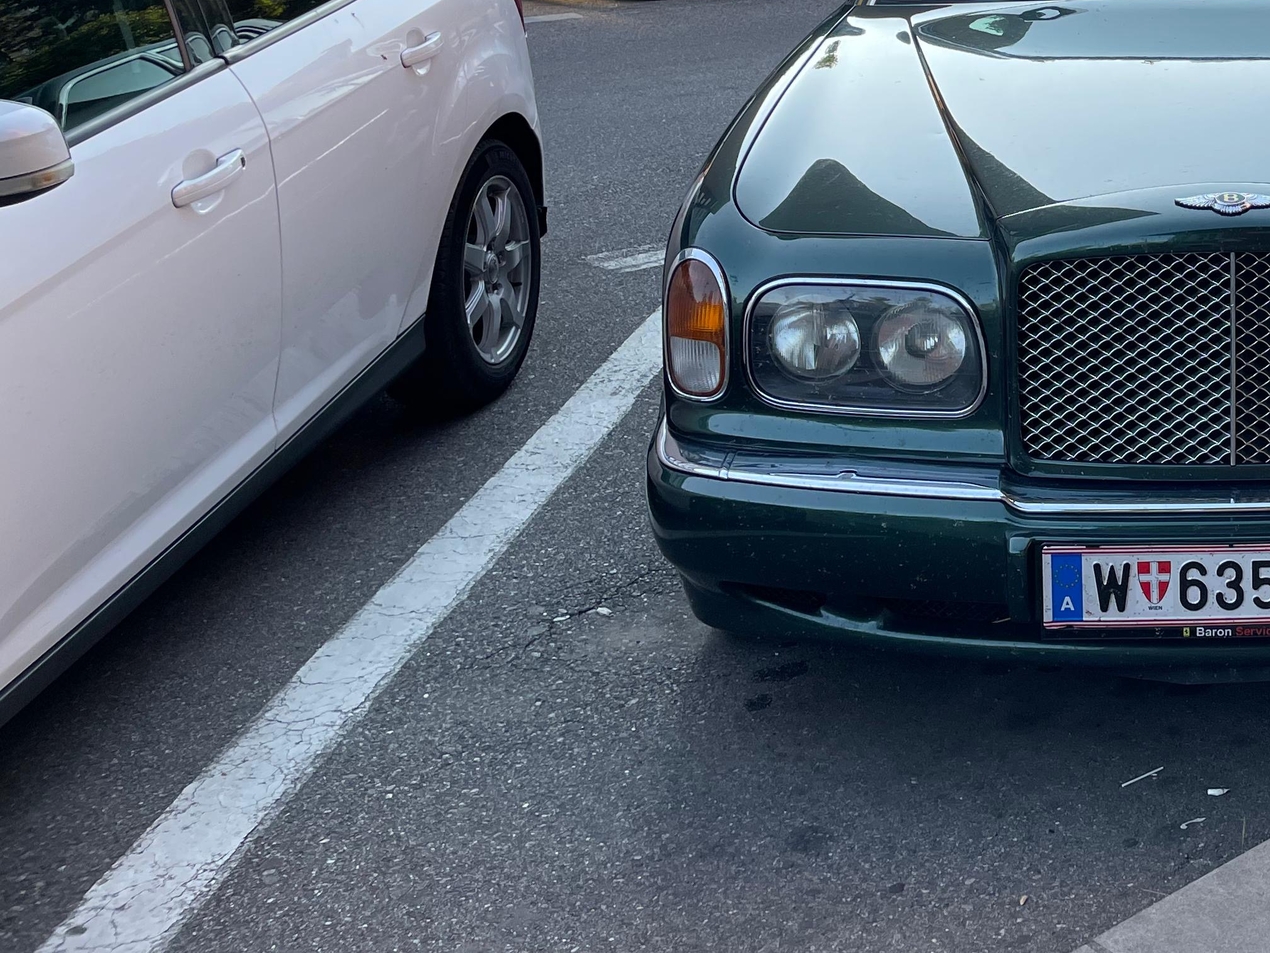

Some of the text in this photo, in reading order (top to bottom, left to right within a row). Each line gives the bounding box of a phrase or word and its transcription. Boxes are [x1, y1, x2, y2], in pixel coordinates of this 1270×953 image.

[1092, 561, 1131, 613] W
[1060, 595, 1075, 611] A
[1196, 626, 1232, 637] Baron
